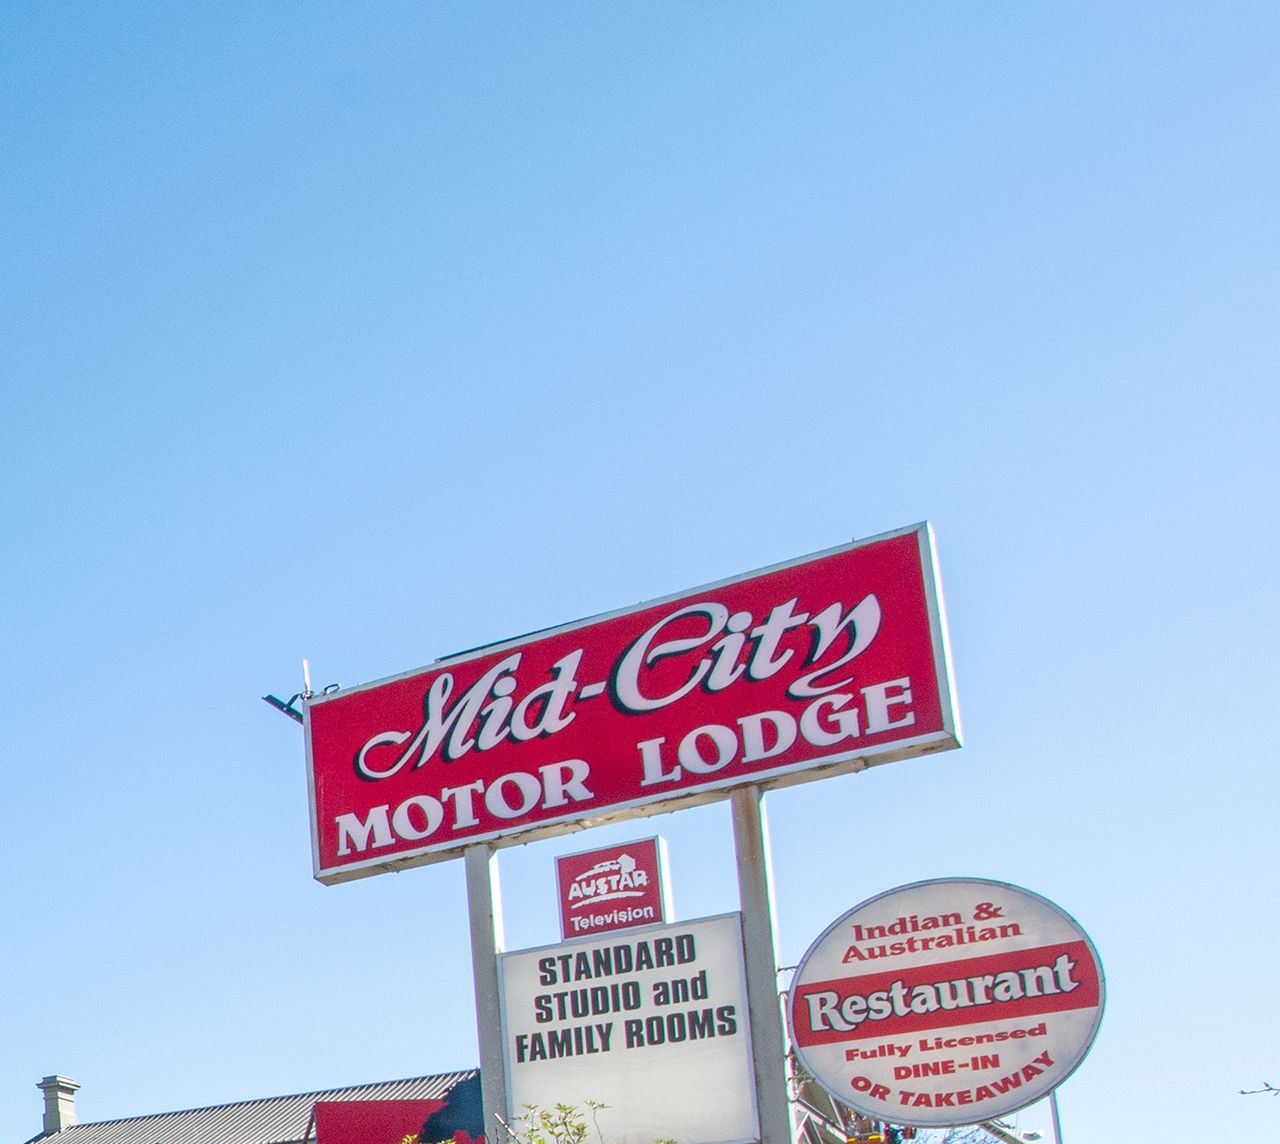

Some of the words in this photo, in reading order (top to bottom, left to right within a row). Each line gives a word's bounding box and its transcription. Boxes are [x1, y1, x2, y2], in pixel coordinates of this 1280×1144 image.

[355, 593, 884, 781] Mid-City
[335, 758, 595, 857] MOTOR
[637, 676, 916, 787] LODGE
[568, 869, 649, 901] AUSTAR
[570, 905, 654, 932] Television
[841, 921, 1024, 964] Australian
[851, 911, 965, 942] Indian
[972, 902, 1006, 921] &
[538, 933, 697, 987] STANDARD
[534, 980, 643, 1024] STUDIO
[652, 969, 709, 1007] and
[802, 952, 1083, 1033] Restaurant
[515, 1022, 614, 1064] FAMILY
[624, 1005, 738, 1050] ROOMS
[845, 1043, 913, 1062] Fully
[919, 1022, 1048, 1053] Licensed
[850, 1075, 891, 1102] OR
[898, 1049, 1056, 1108] TAKEAWAY
[893, 1053, 1001, 1081] DINE-IN
